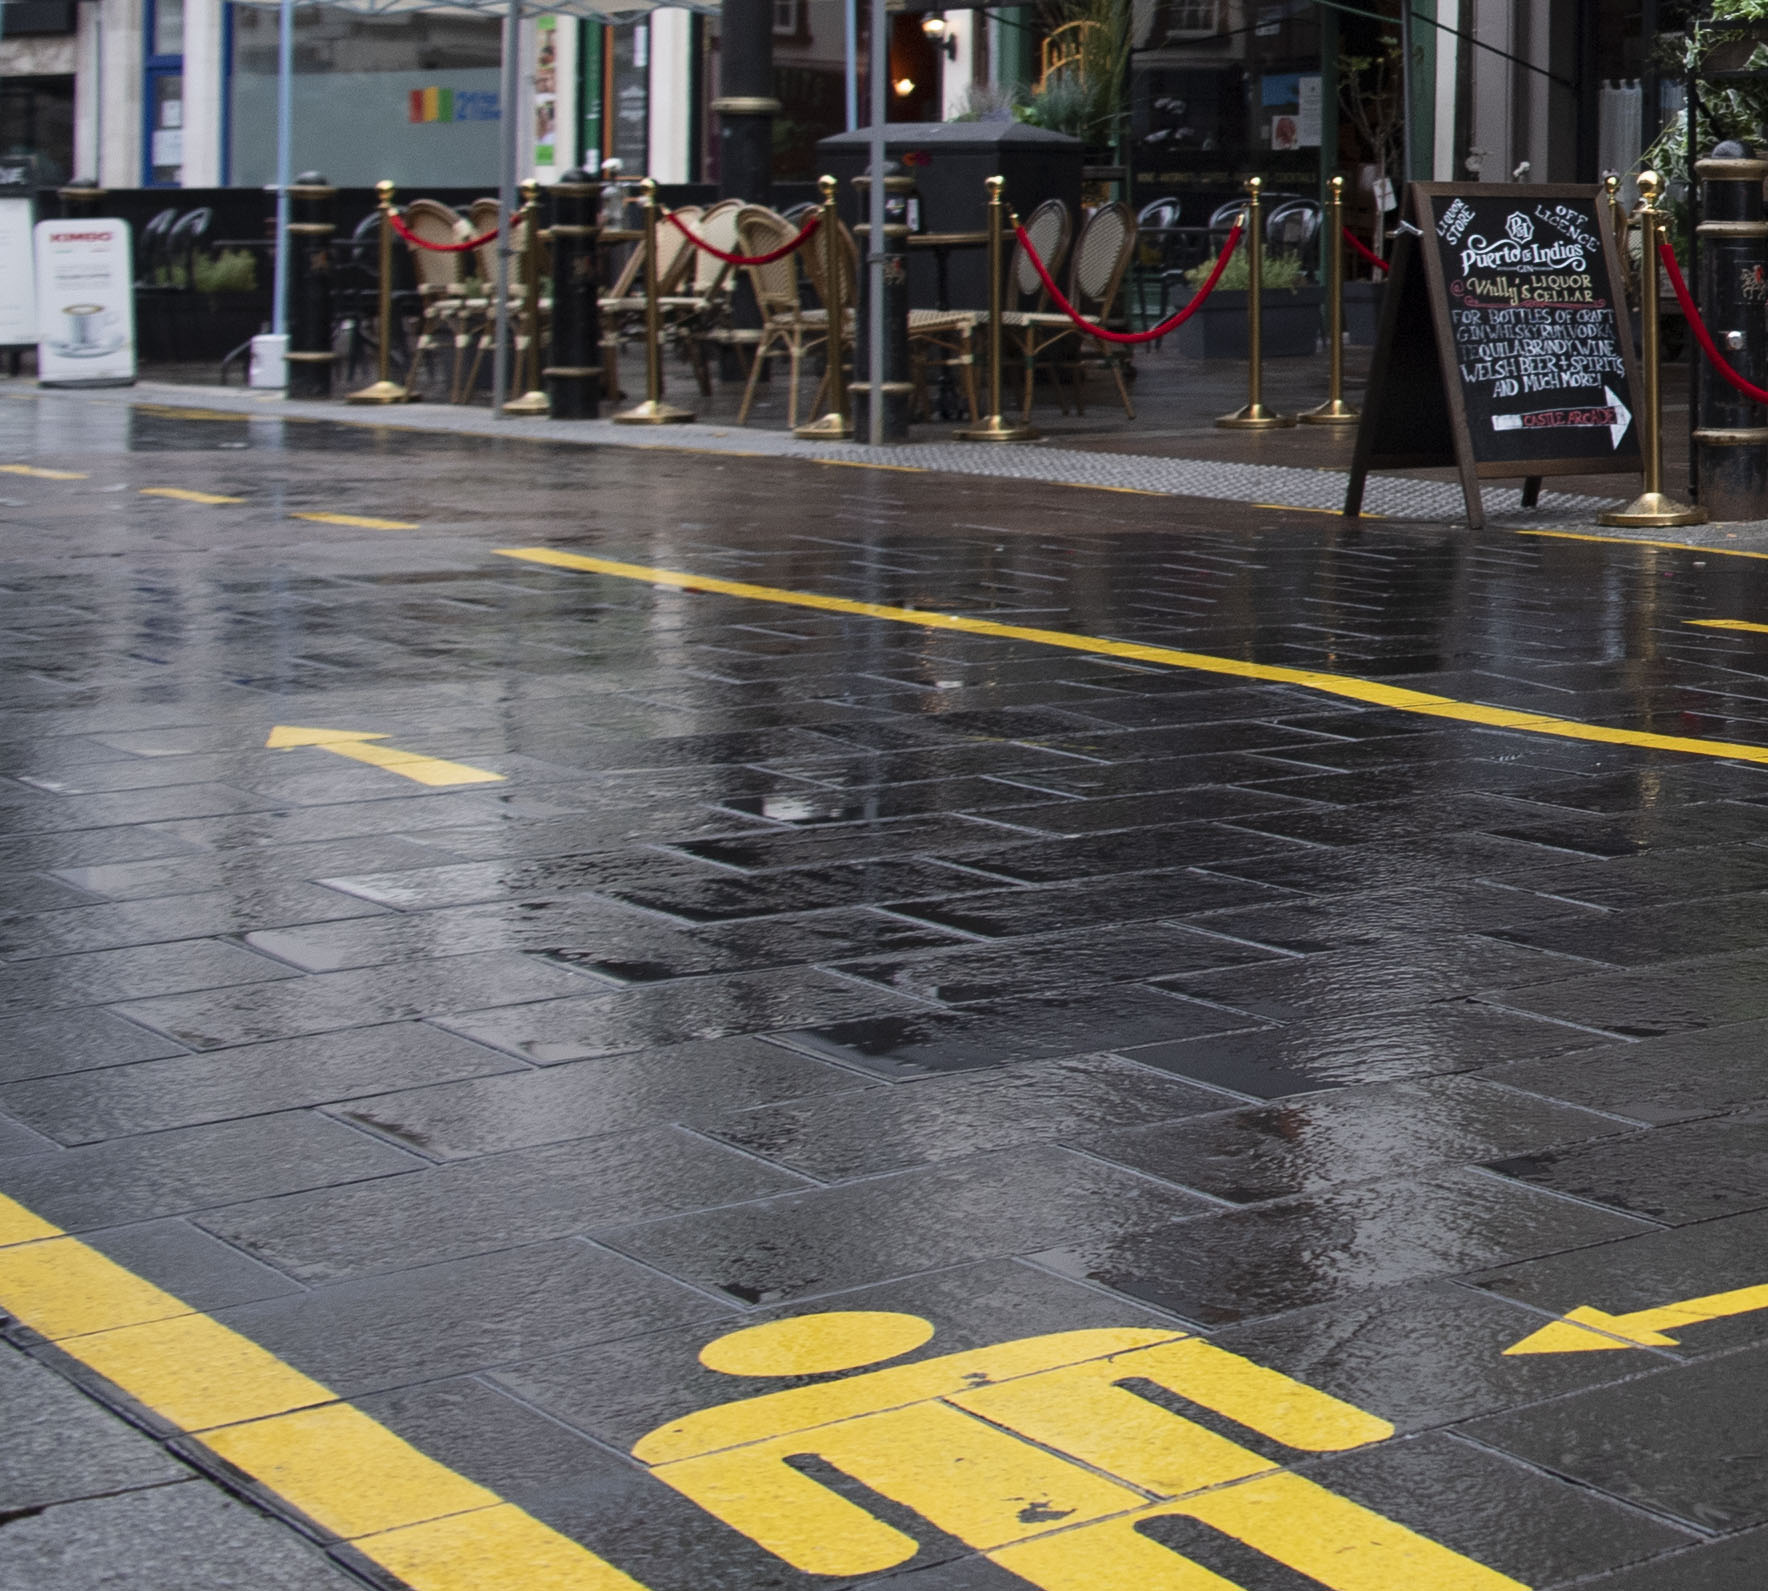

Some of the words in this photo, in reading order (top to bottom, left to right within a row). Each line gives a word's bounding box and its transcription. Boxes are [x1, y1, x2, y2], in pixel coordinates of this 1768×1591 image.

[1436, 198, 1466, 237] LIQUOR
[1446, 205, 1476, 246] STORE
[1555, 205, 1589, 225] OFF
[1534, 205, 1599, 252] LICENCE
[1460, 241, 1520, 276] Puerto
[1530, 241, 1585, 268] Indias
[1531, 274, 1592, 289] LIQUOR
[1533, 289, 1593, 303] CELLAR
[1452, 309, 1481, 324] FOR
[1488, 308, 1551, 324] BOTTLES
[1555, 309, 1574, 324] OF
[1576, 308, 1615, 324] CRAFT
[1460, 358, 1516, 383] WELSH
[1519, 357, 1557, 375] BEER
[1493, 378, 1519, 398] AND
[1523, 374, 1560, 393] MUCH
[1561, 371, 1603, 389] MORE!
[1523, 411, 1565, 426] CASTLE
[1567, 408, 1616, 425] ARCADE
